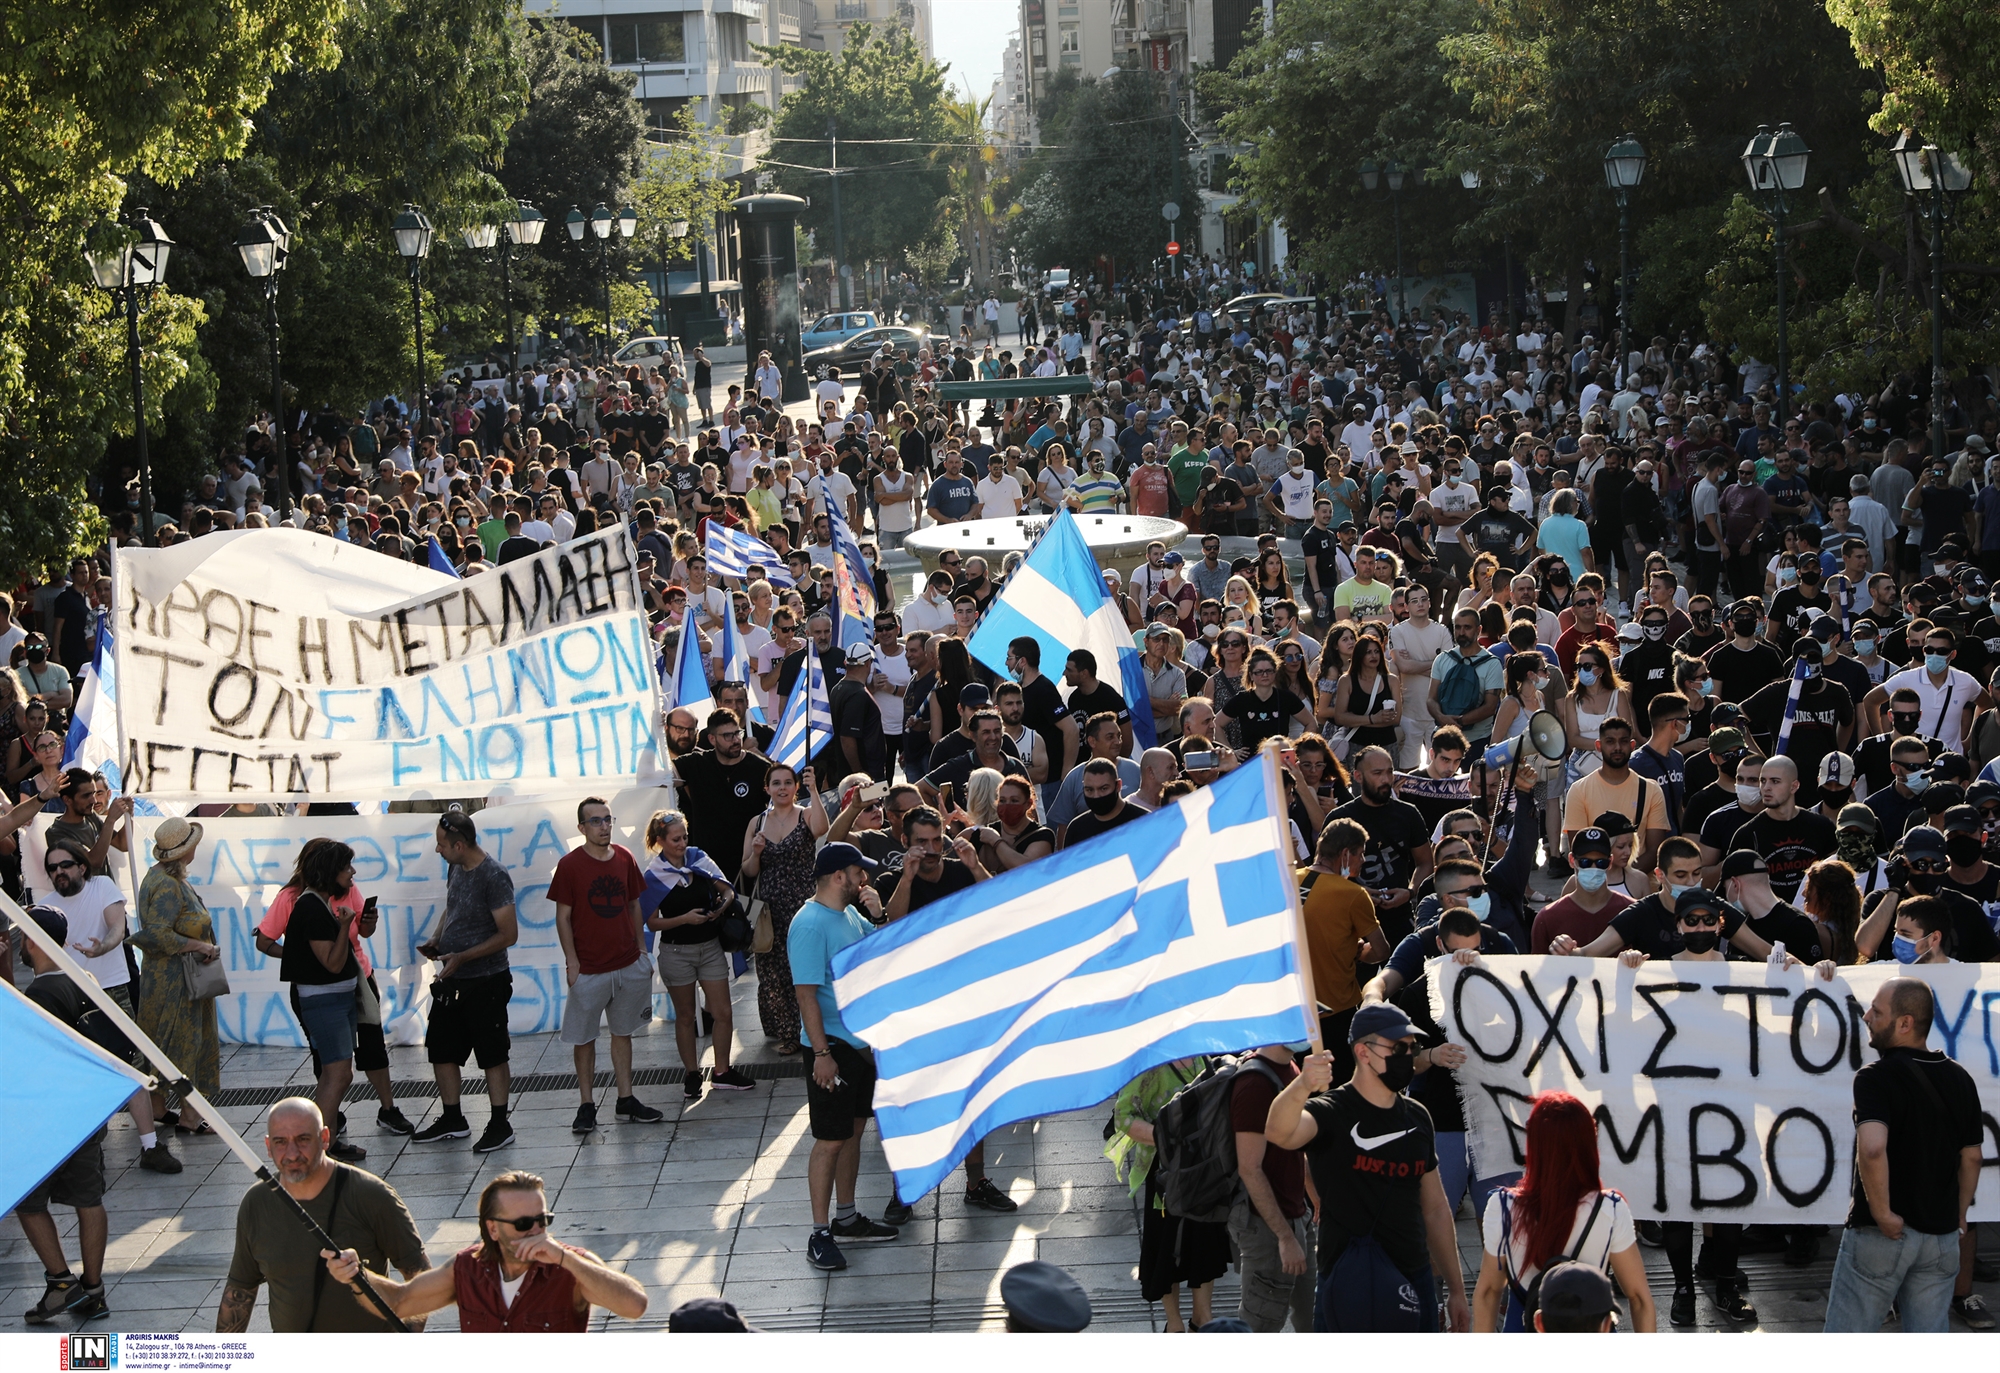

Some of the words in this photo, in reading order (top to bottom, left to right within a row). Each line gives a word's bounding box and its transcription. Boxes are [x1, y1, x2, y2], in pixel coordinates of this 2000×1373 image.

[298, 616, 333, 684] Η
[1647, 667, 1666, 680] NIKE
[1452, 966, 1609, 1078] ΟΧΙ
